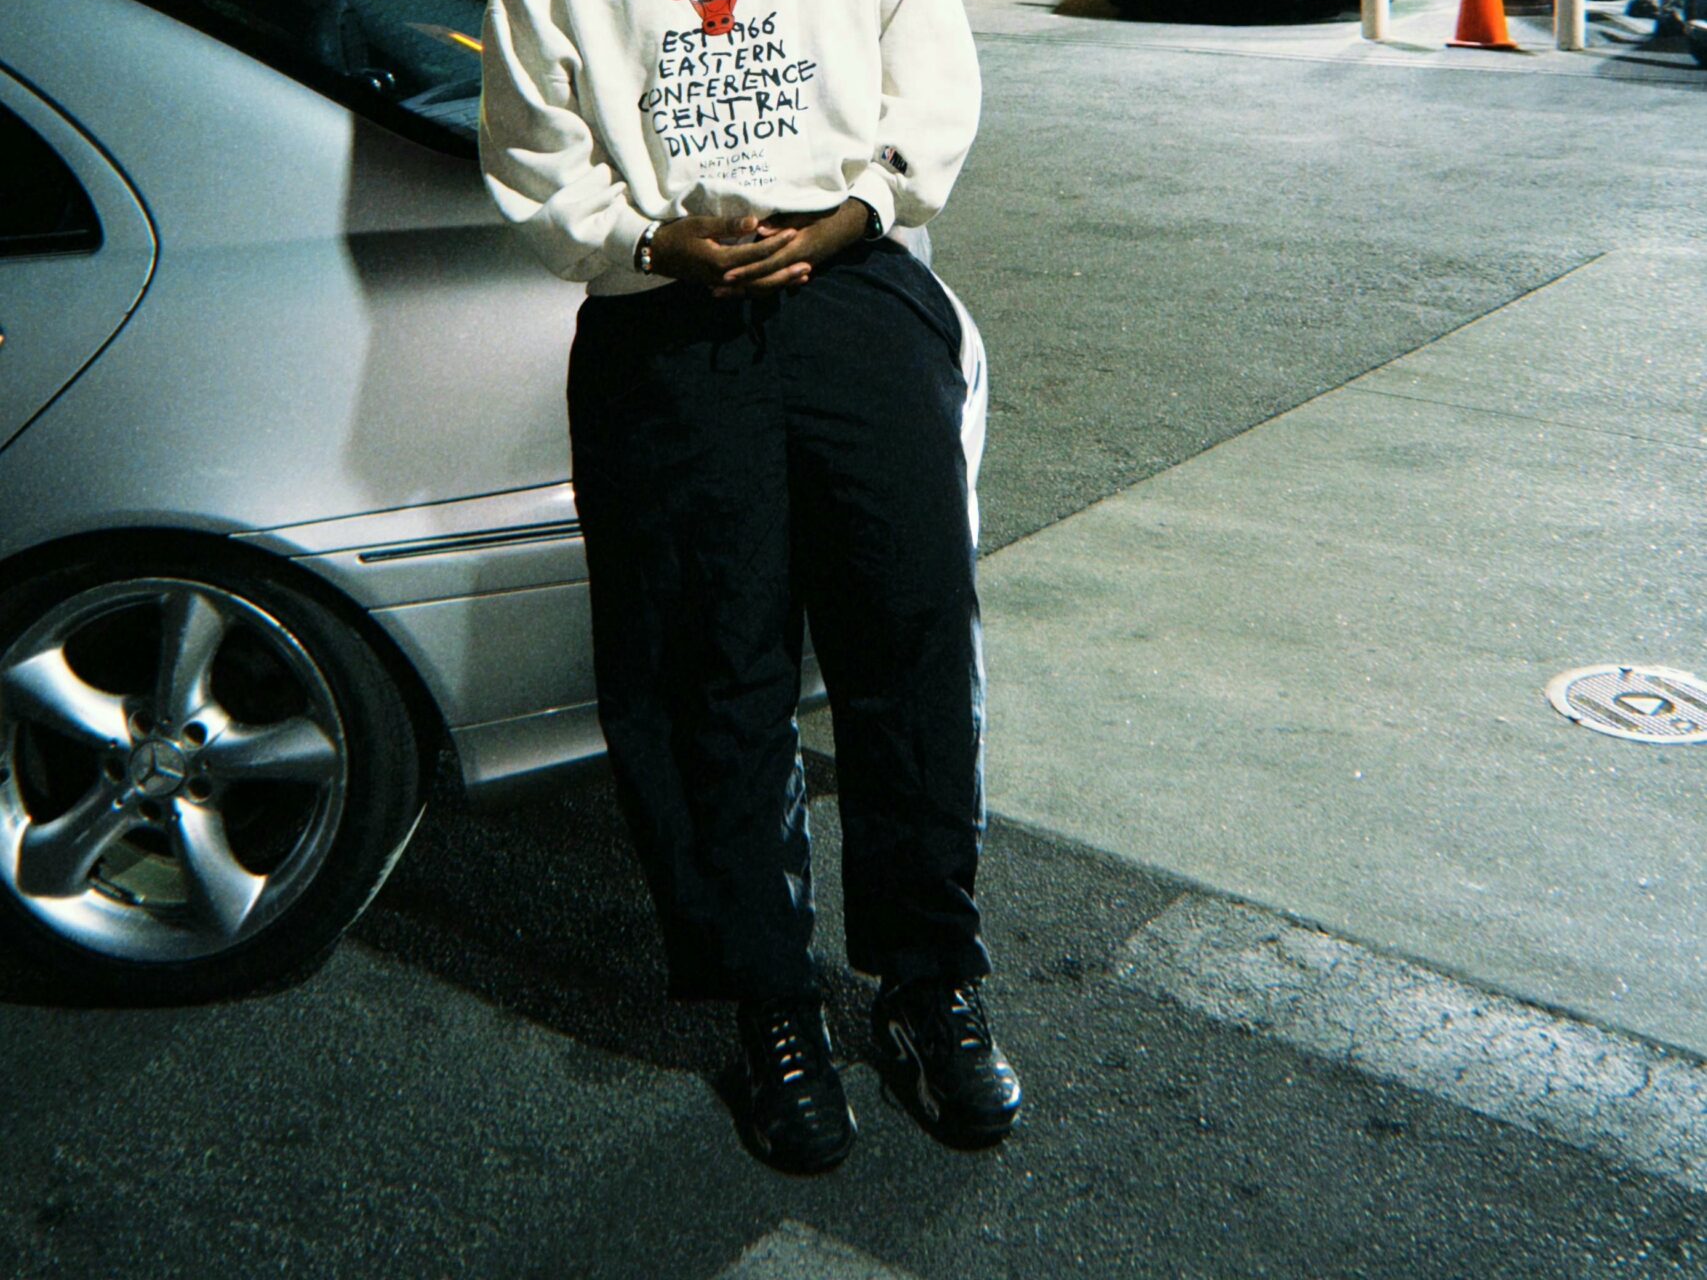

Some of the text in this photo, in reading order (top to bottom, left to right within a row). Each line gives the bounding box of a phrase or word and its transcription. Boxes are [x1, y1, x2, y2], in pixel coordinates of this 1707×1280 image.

[659, 39, 786, 79] EASTERN
[662, 28, 708, 53] EST
[638, 60, 817, 112] CONFERENCE
[652, 88, 808, 134] CENTRAL
[664, 116, 799, 157] DIVISION
